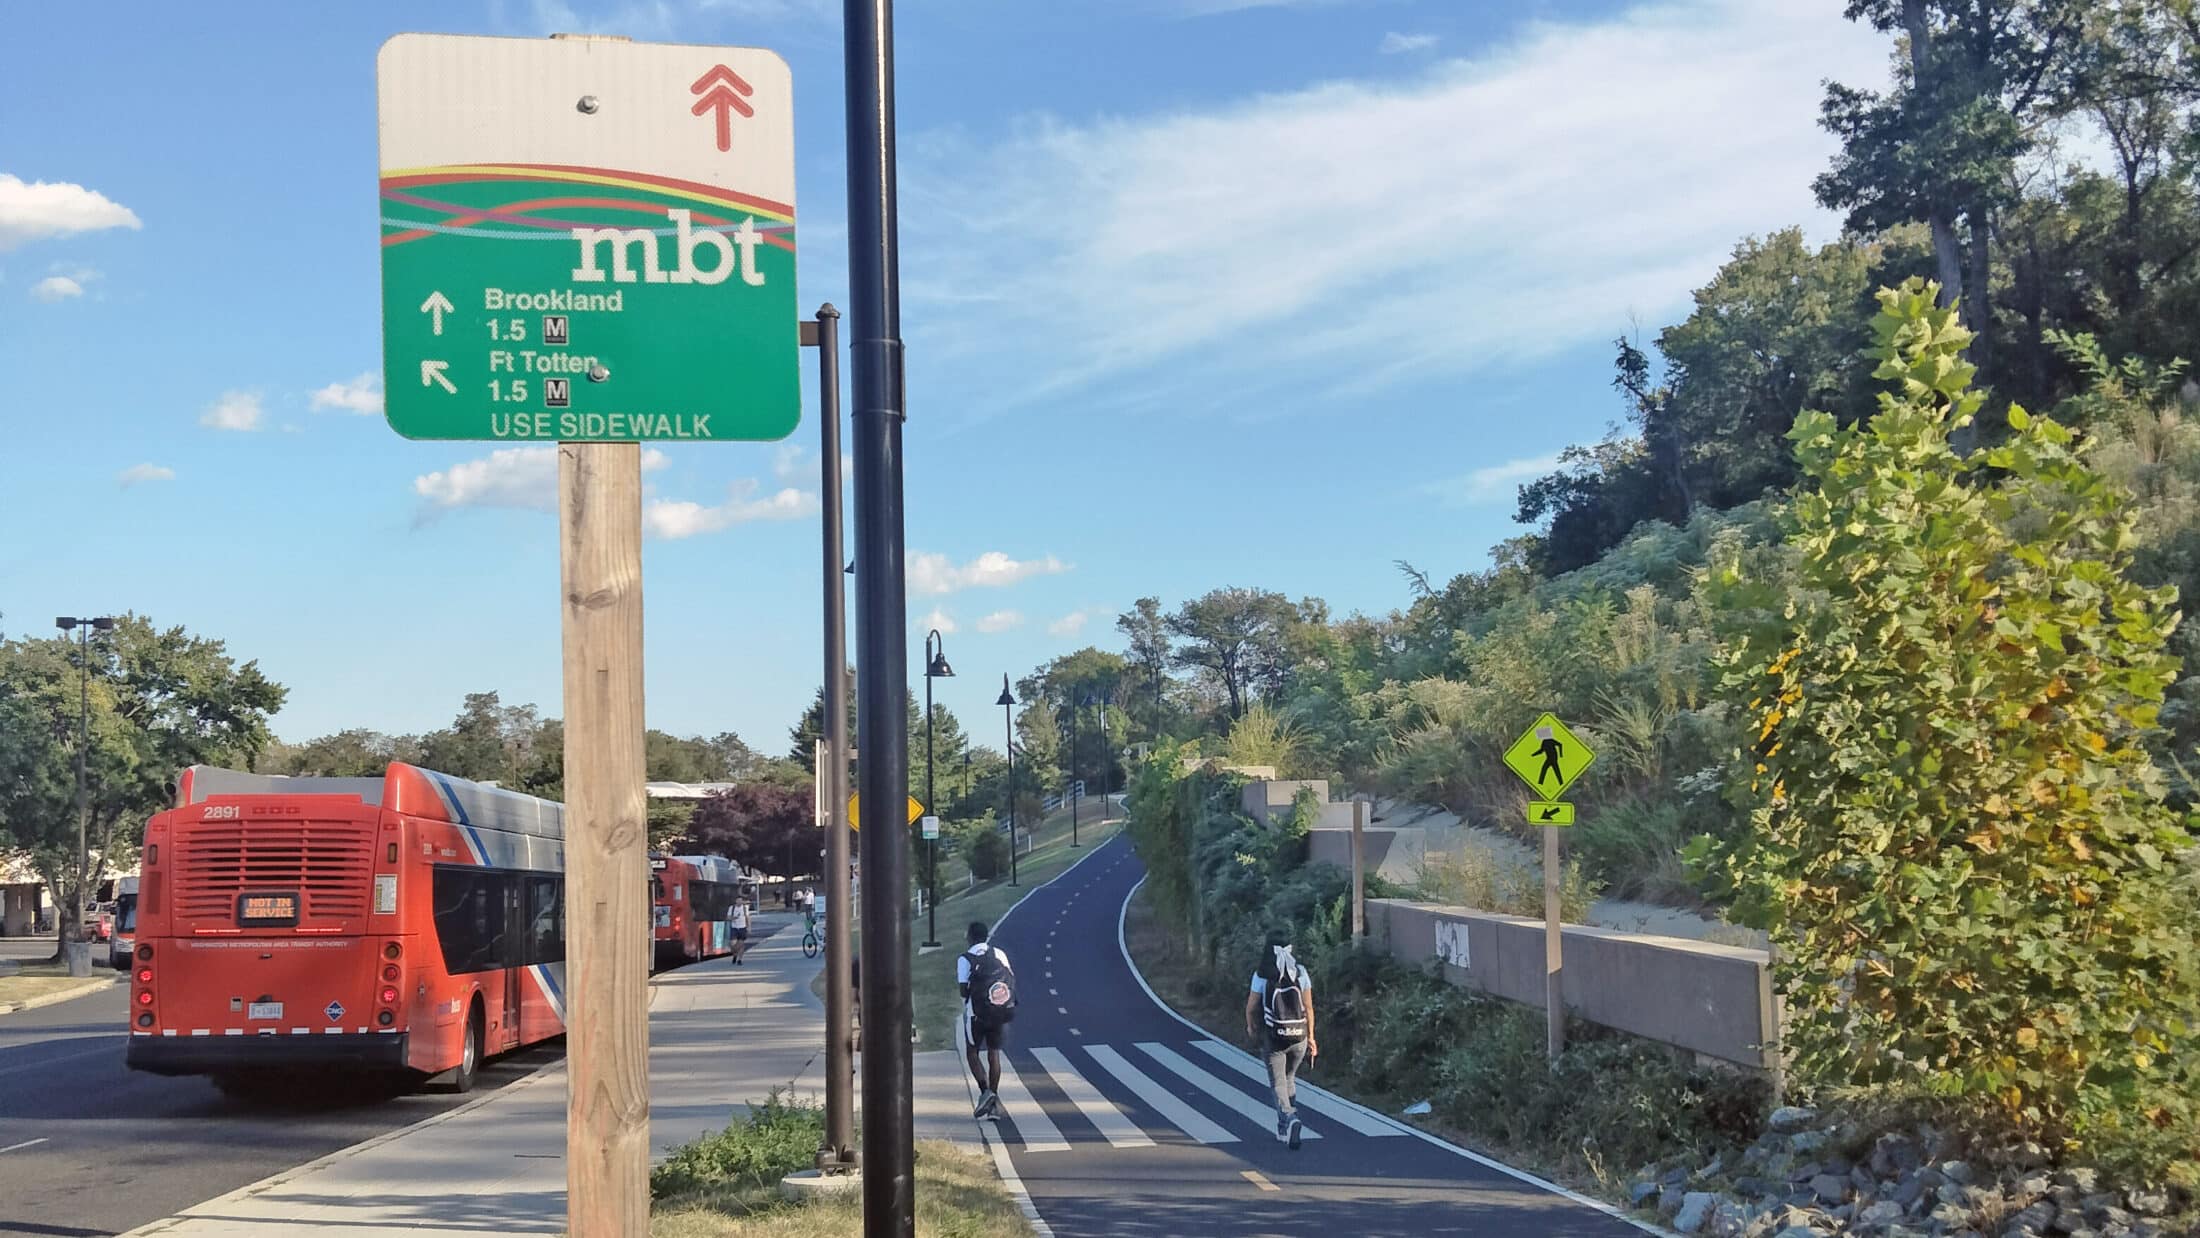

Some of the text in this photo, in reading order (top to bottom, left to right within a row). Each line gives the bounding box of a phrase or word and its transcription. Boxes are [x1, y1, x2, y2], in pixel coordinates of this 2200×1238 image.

[571, 208, 765, 286] mbt
[485, 288, 623, 312] Brookland
[486, 319, 526, 341] 1.5
[489, 351, 598, 373] Ft Totten
[488, 379, 528, 402] 1.5
[491, 413, 712, 438] USE SIDEWALK
[203, 806, 240, 819] 2891
[245, 908, 295, 918] SERVICE
[248, 898, 292, 907] NOT IN
